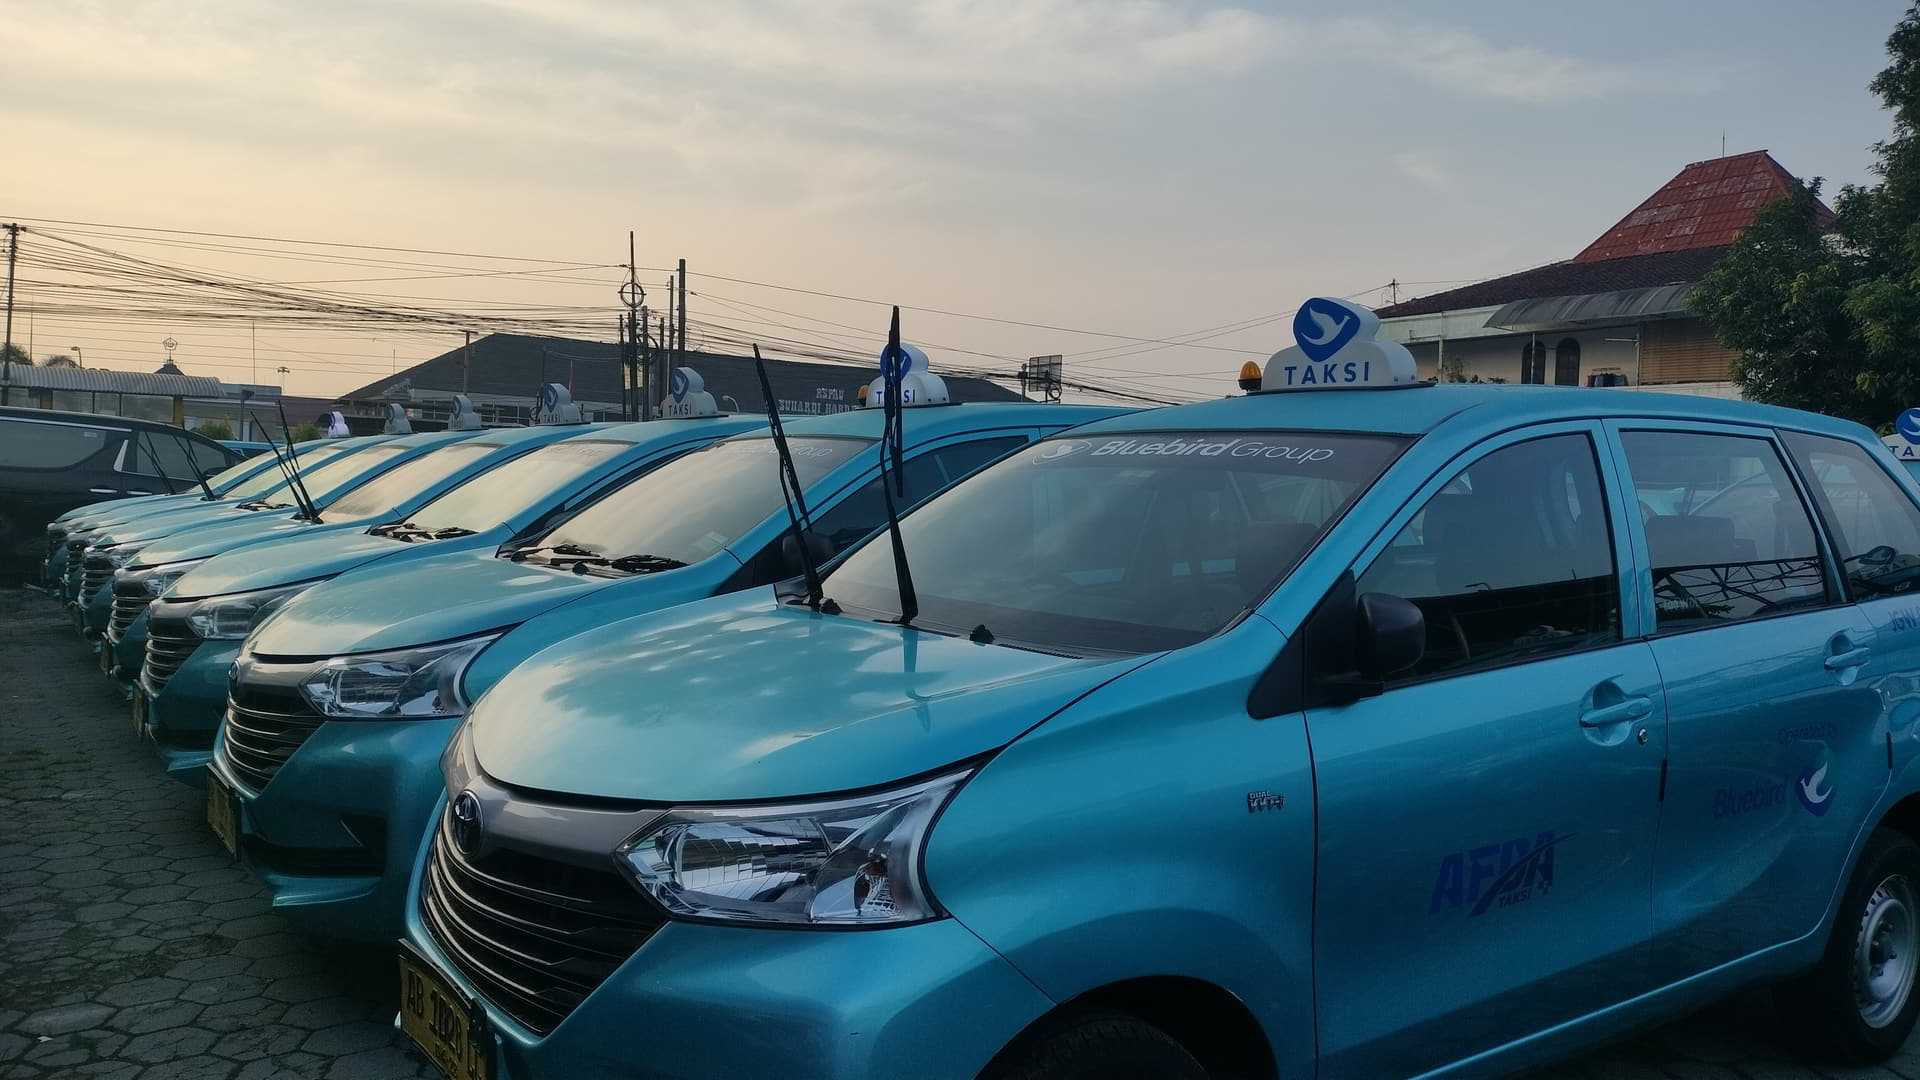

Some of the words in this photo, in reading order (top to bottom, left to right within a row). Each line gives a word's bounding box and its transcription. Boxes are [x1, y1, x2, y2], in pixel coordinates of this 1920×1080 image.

[1284, 361, 1370, 386] TAKSI
[876, 389, 916, 404] TSI
[668, 403, 692, 416] TAKSI
[1230, 442, 1335, 465] Group
[1888, 445, 1920, 457] TA
[1713, 776, 1789, 819] Bluebird
[407, 968, 424, 1018] AB
